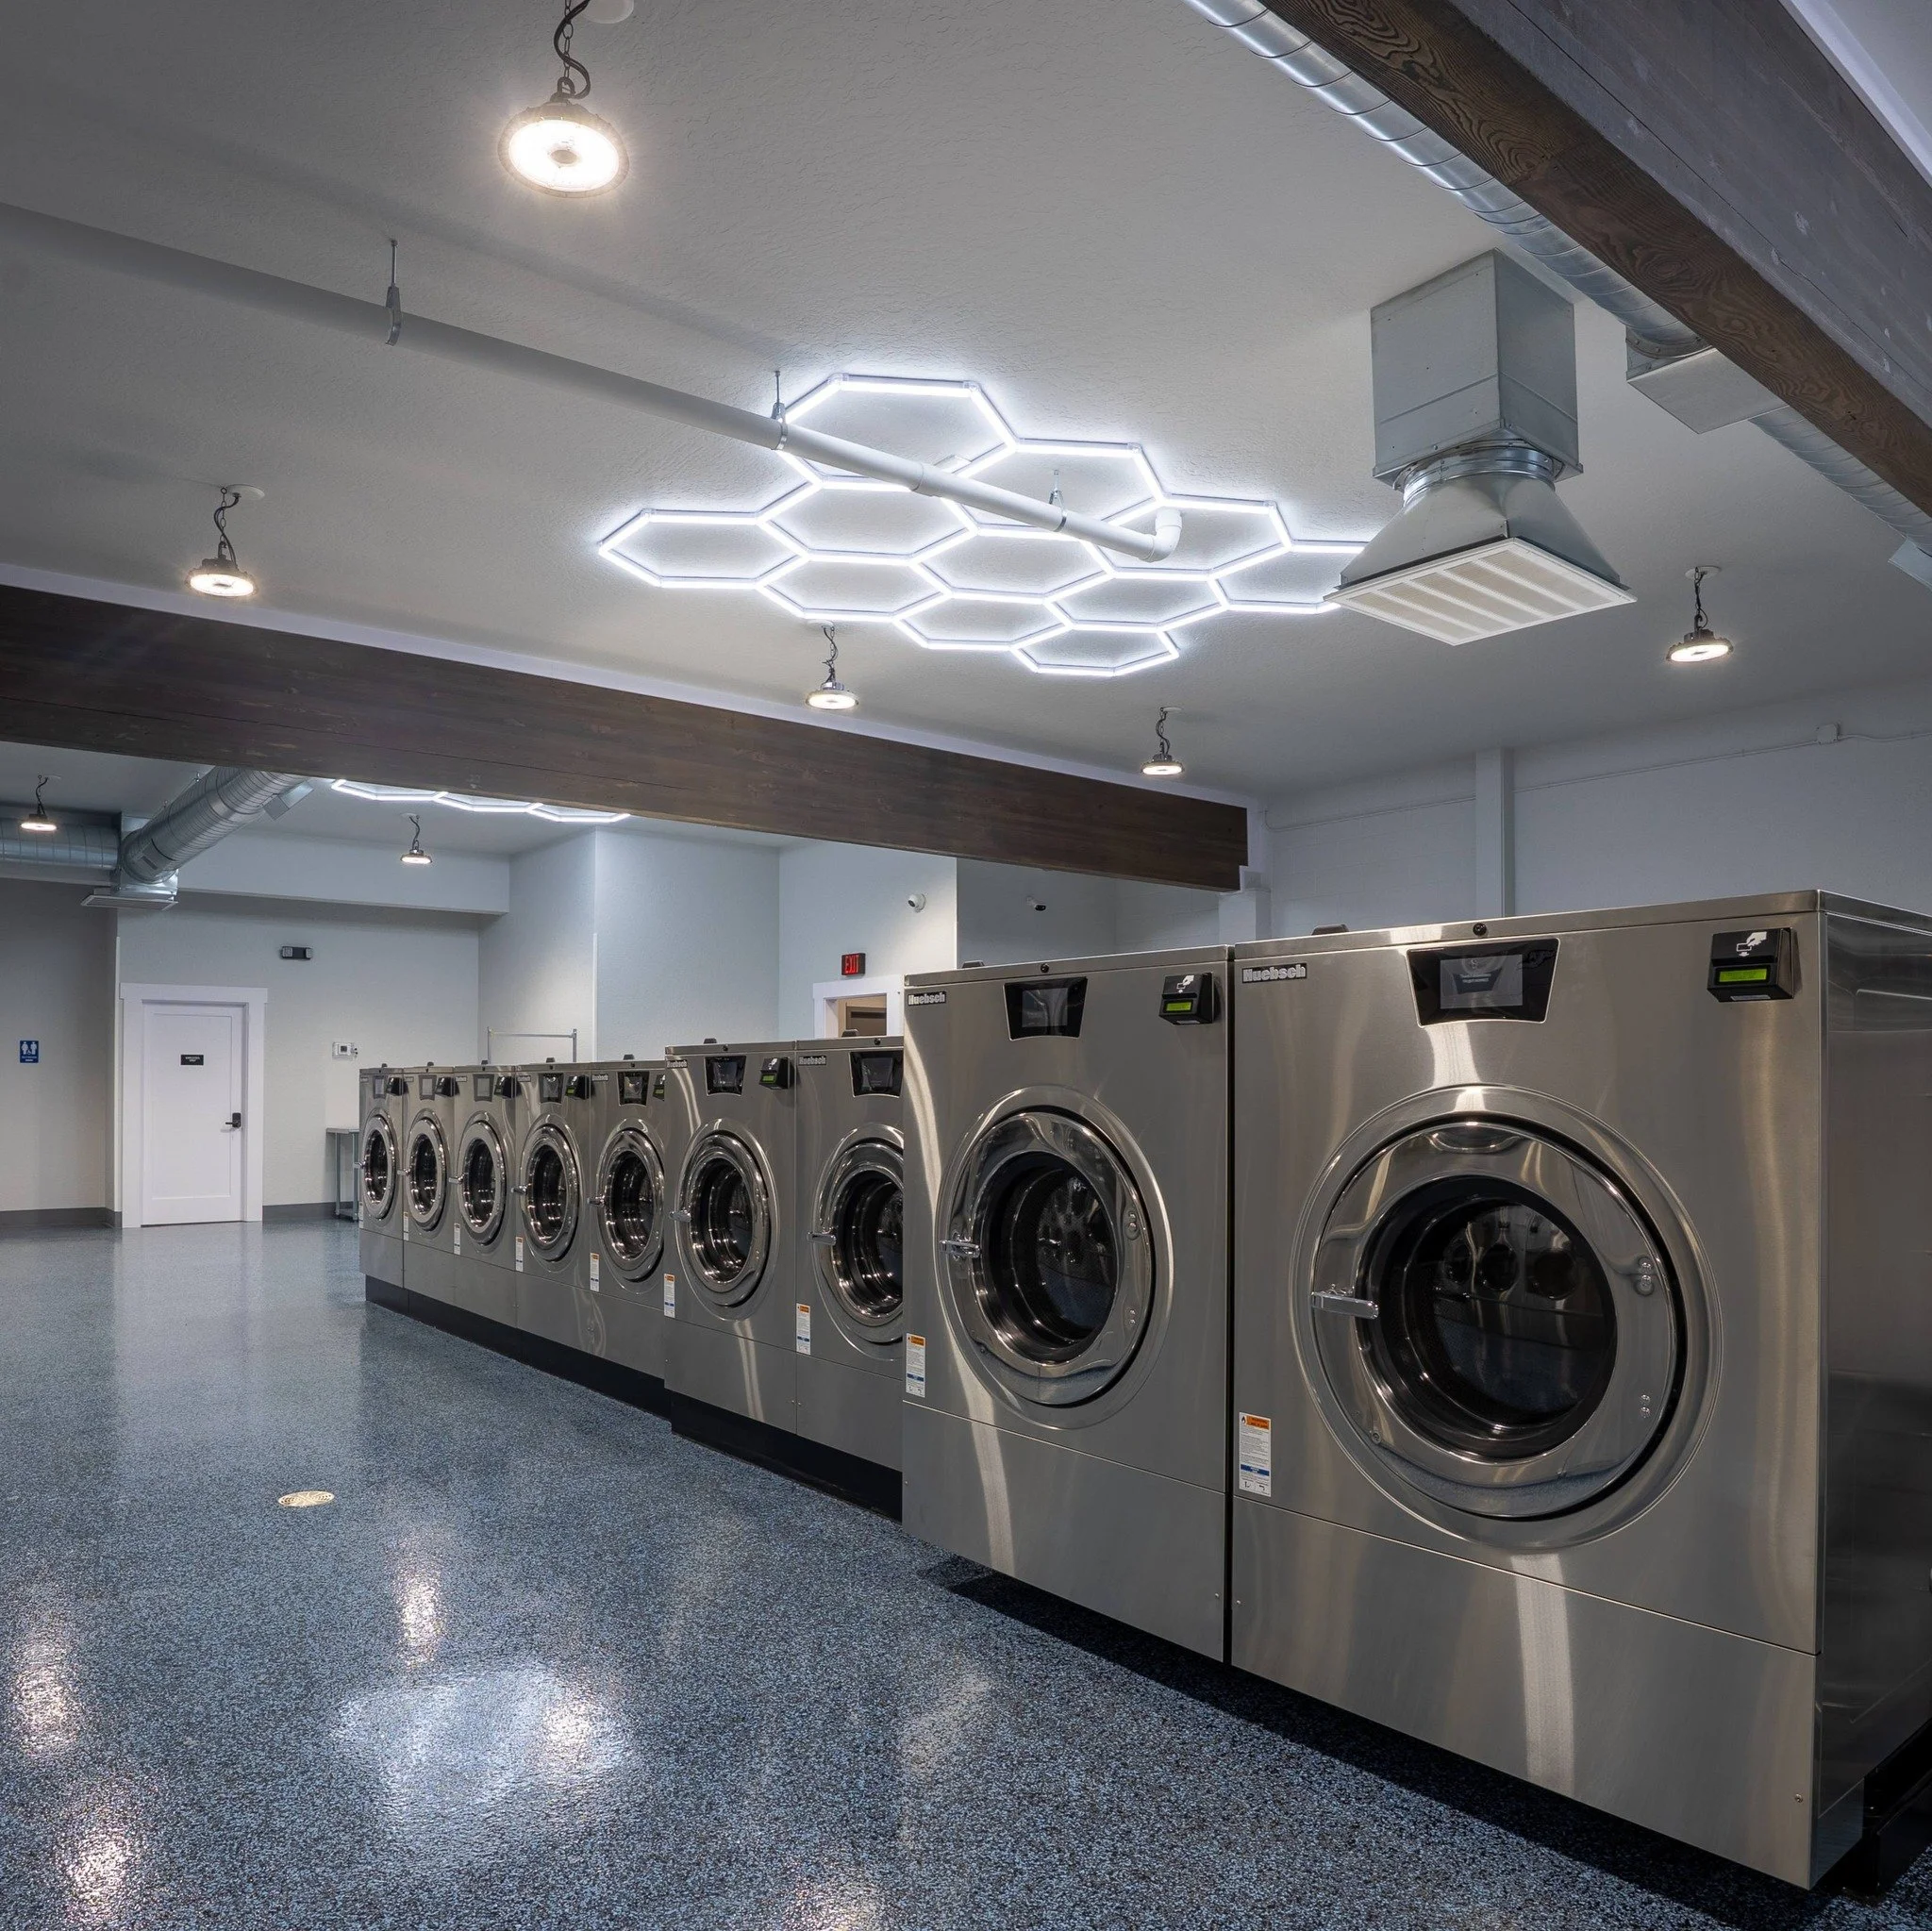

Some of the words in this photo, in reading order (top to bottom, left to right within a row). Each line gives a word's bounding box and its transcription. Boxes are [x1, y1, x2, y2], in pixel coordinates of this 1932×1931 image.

[845, 955, 858, 974] EXIT
[1242, 964, 1306, 982] Huebsch
[908, 992, 945, 1006] Huebsch
